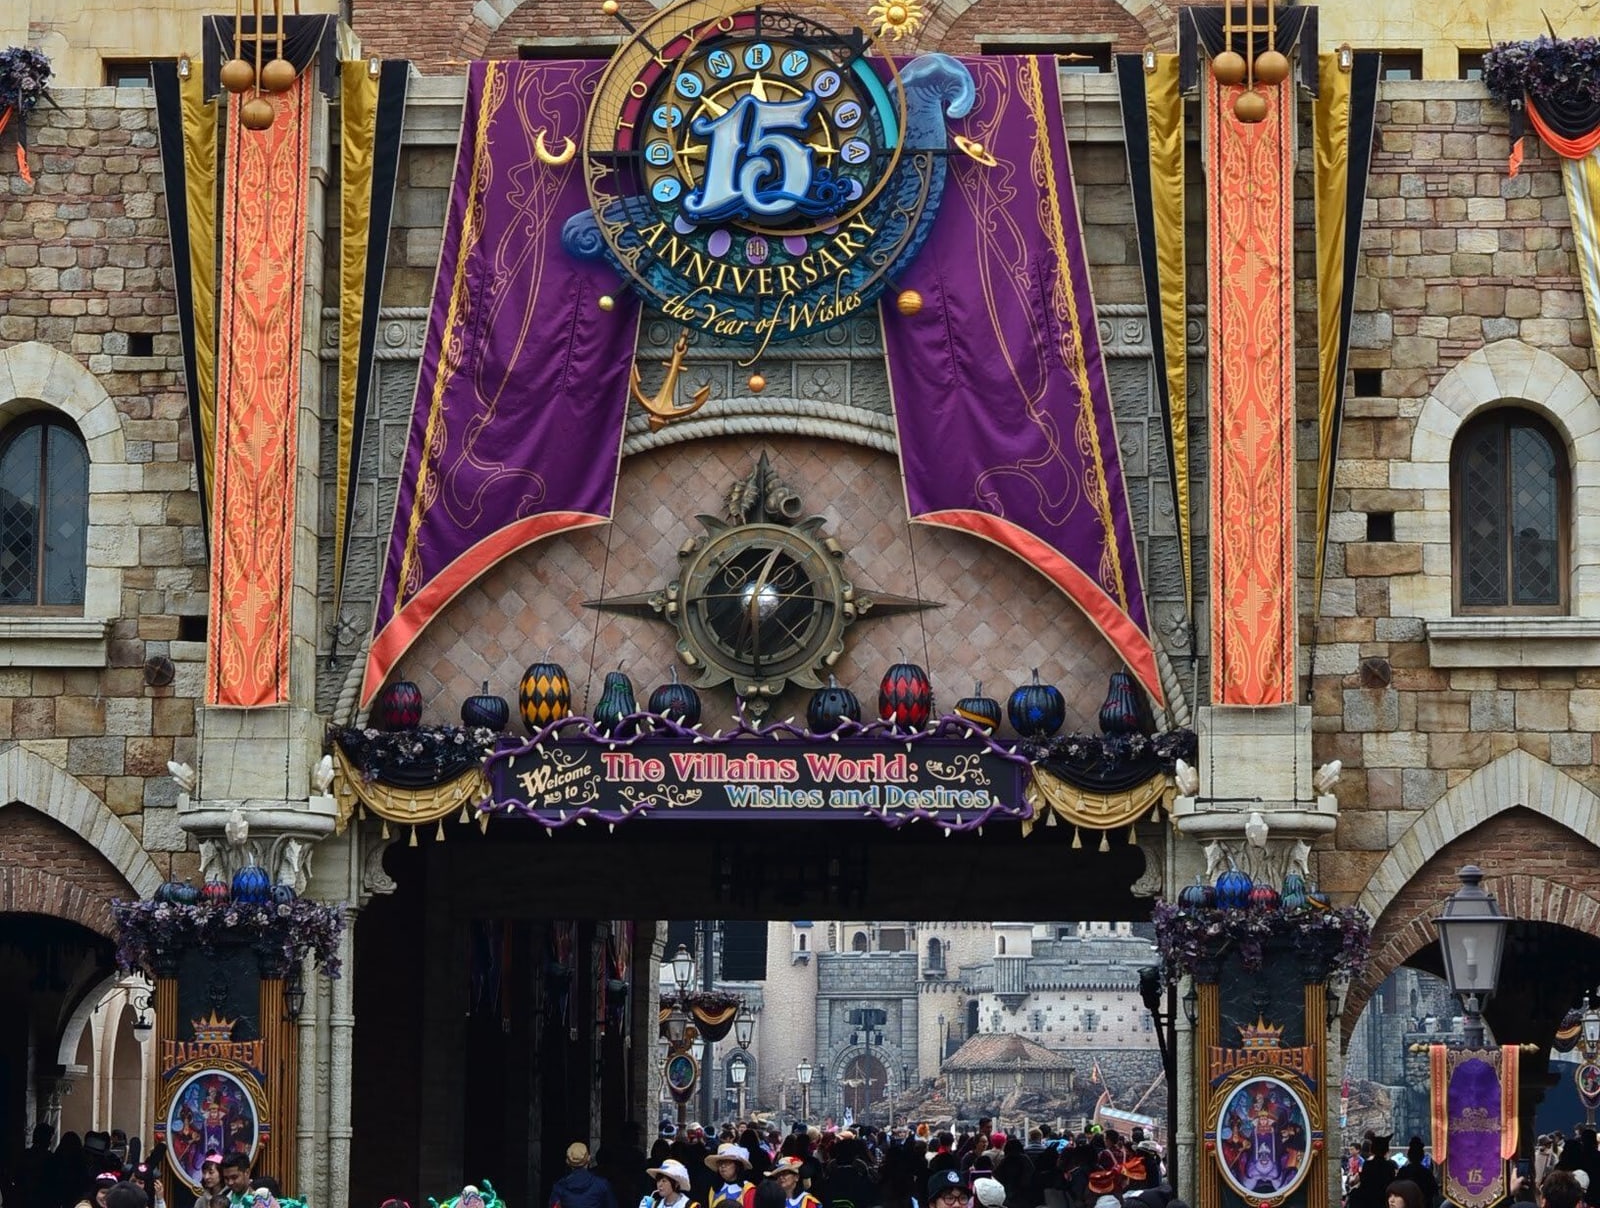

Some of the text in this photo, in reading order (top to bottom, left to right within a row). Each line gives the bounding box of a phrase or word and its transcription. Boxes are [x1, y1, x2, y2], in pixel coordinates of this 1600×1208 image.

[617, 15, 734, 130] TOKYO
[683, 94, 816, 216] 15
[639, 212, 876, 295] ANNIVERSARY
[748, 239, 764, 261] th
[661, 269, 861, 366] the Year of Wishes
[516, 764, 592, 797] Welcome
[601, 752, 919, 783] The Villains World:
[565, 783, 578, 800] to
[724, 784, 990, 809] Wishes and Desires
[162, 1039, 266, 1073] HALLOWEEN
[1208, 1045, 1317, 1081] HALLOWEEN
